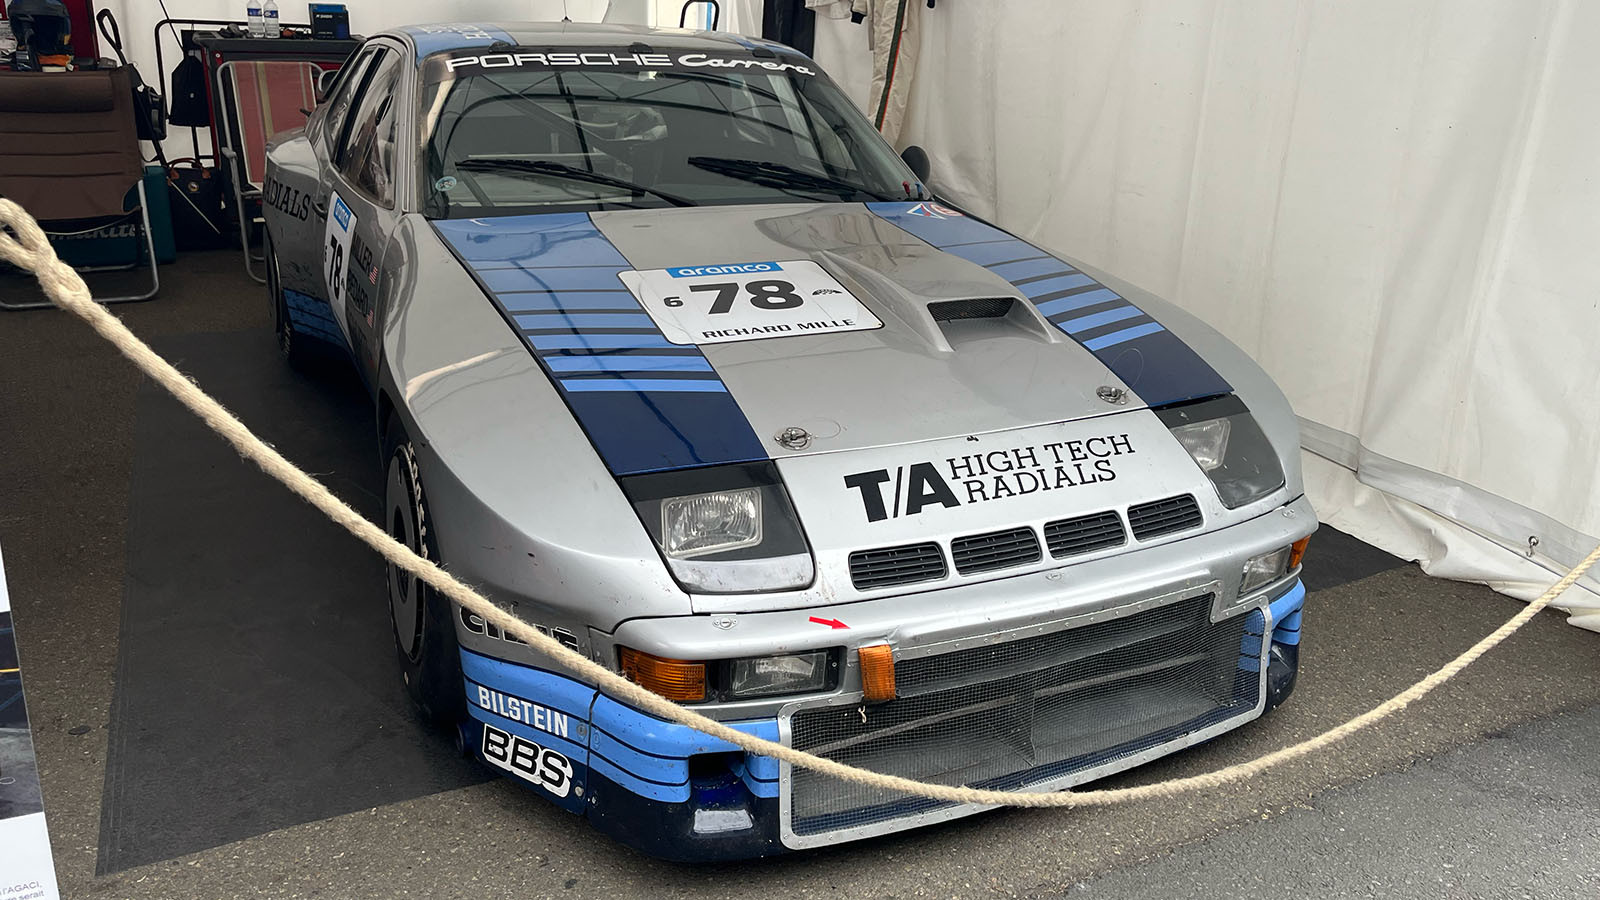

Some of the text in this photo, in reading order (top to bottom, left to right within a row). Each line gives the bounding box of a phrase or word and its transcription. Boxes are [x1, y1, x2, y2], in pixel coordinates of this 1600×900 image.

[445, 53, 816, 76] PORSCHE Carrera
[329, 234, 343, 300] 78
[677, 262, 772, 276] aramco
[664, 280, 804, 315] 6 78
[702, 319, 856, 339] RICHARD MILLE
[946, 434, 1136, 480] HIGH TECH
[844, 461, 961, 523] T/A
[963, 459, 1116, 504] RADIALS
[478, 686, 568, 738] BILSTEIN
[483, 724, 572, 796] BBS
